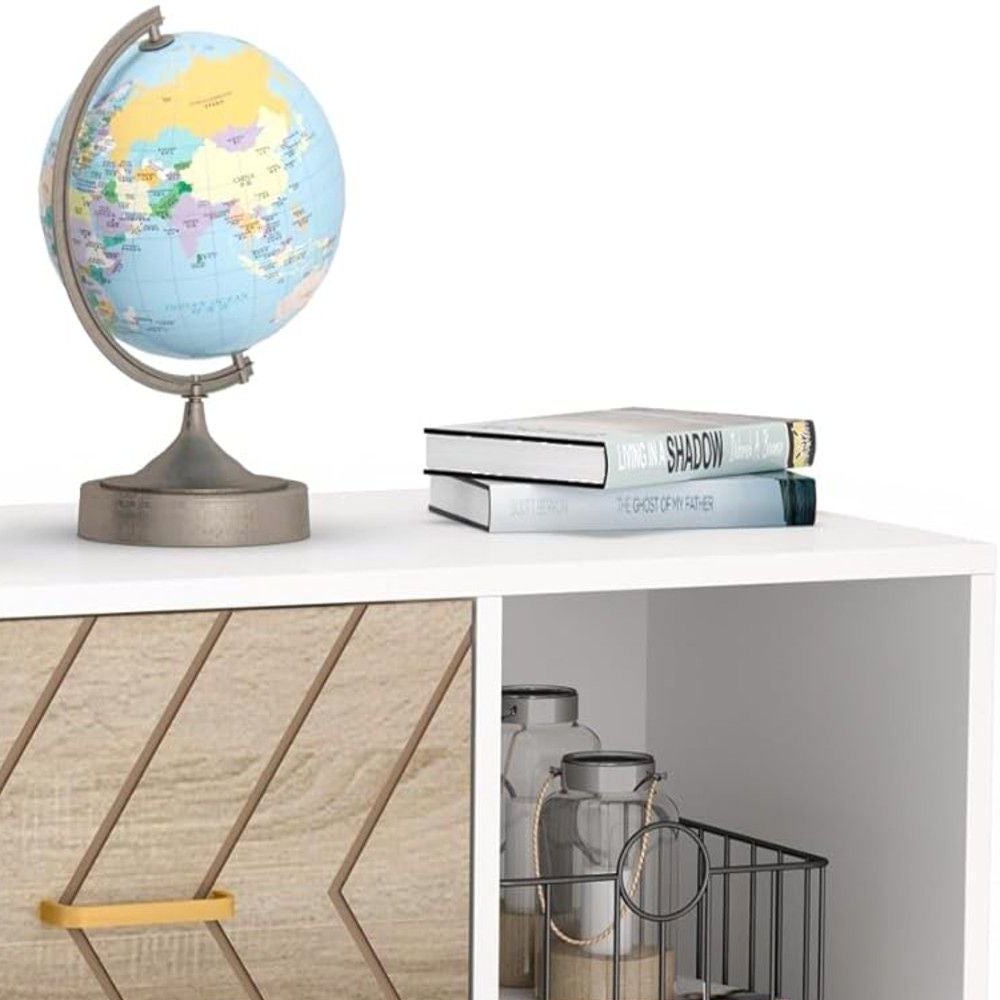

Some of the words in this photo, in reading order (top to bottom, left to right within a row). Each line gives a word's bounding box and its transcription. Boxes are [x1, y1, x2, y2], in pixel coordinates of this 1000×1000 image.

[618, 442, 647, 470] LIVING
[648, 442, 658, 468] IN
[666, 430, 724, 473] SHADOW
[617, 495, 631, 513] THE
[632, 494, 660, 513] GHOST
[660, 495, 672, 512] OF
[672, 495, 684, 511] MY
[685, 495, 714, 511] FATHER
